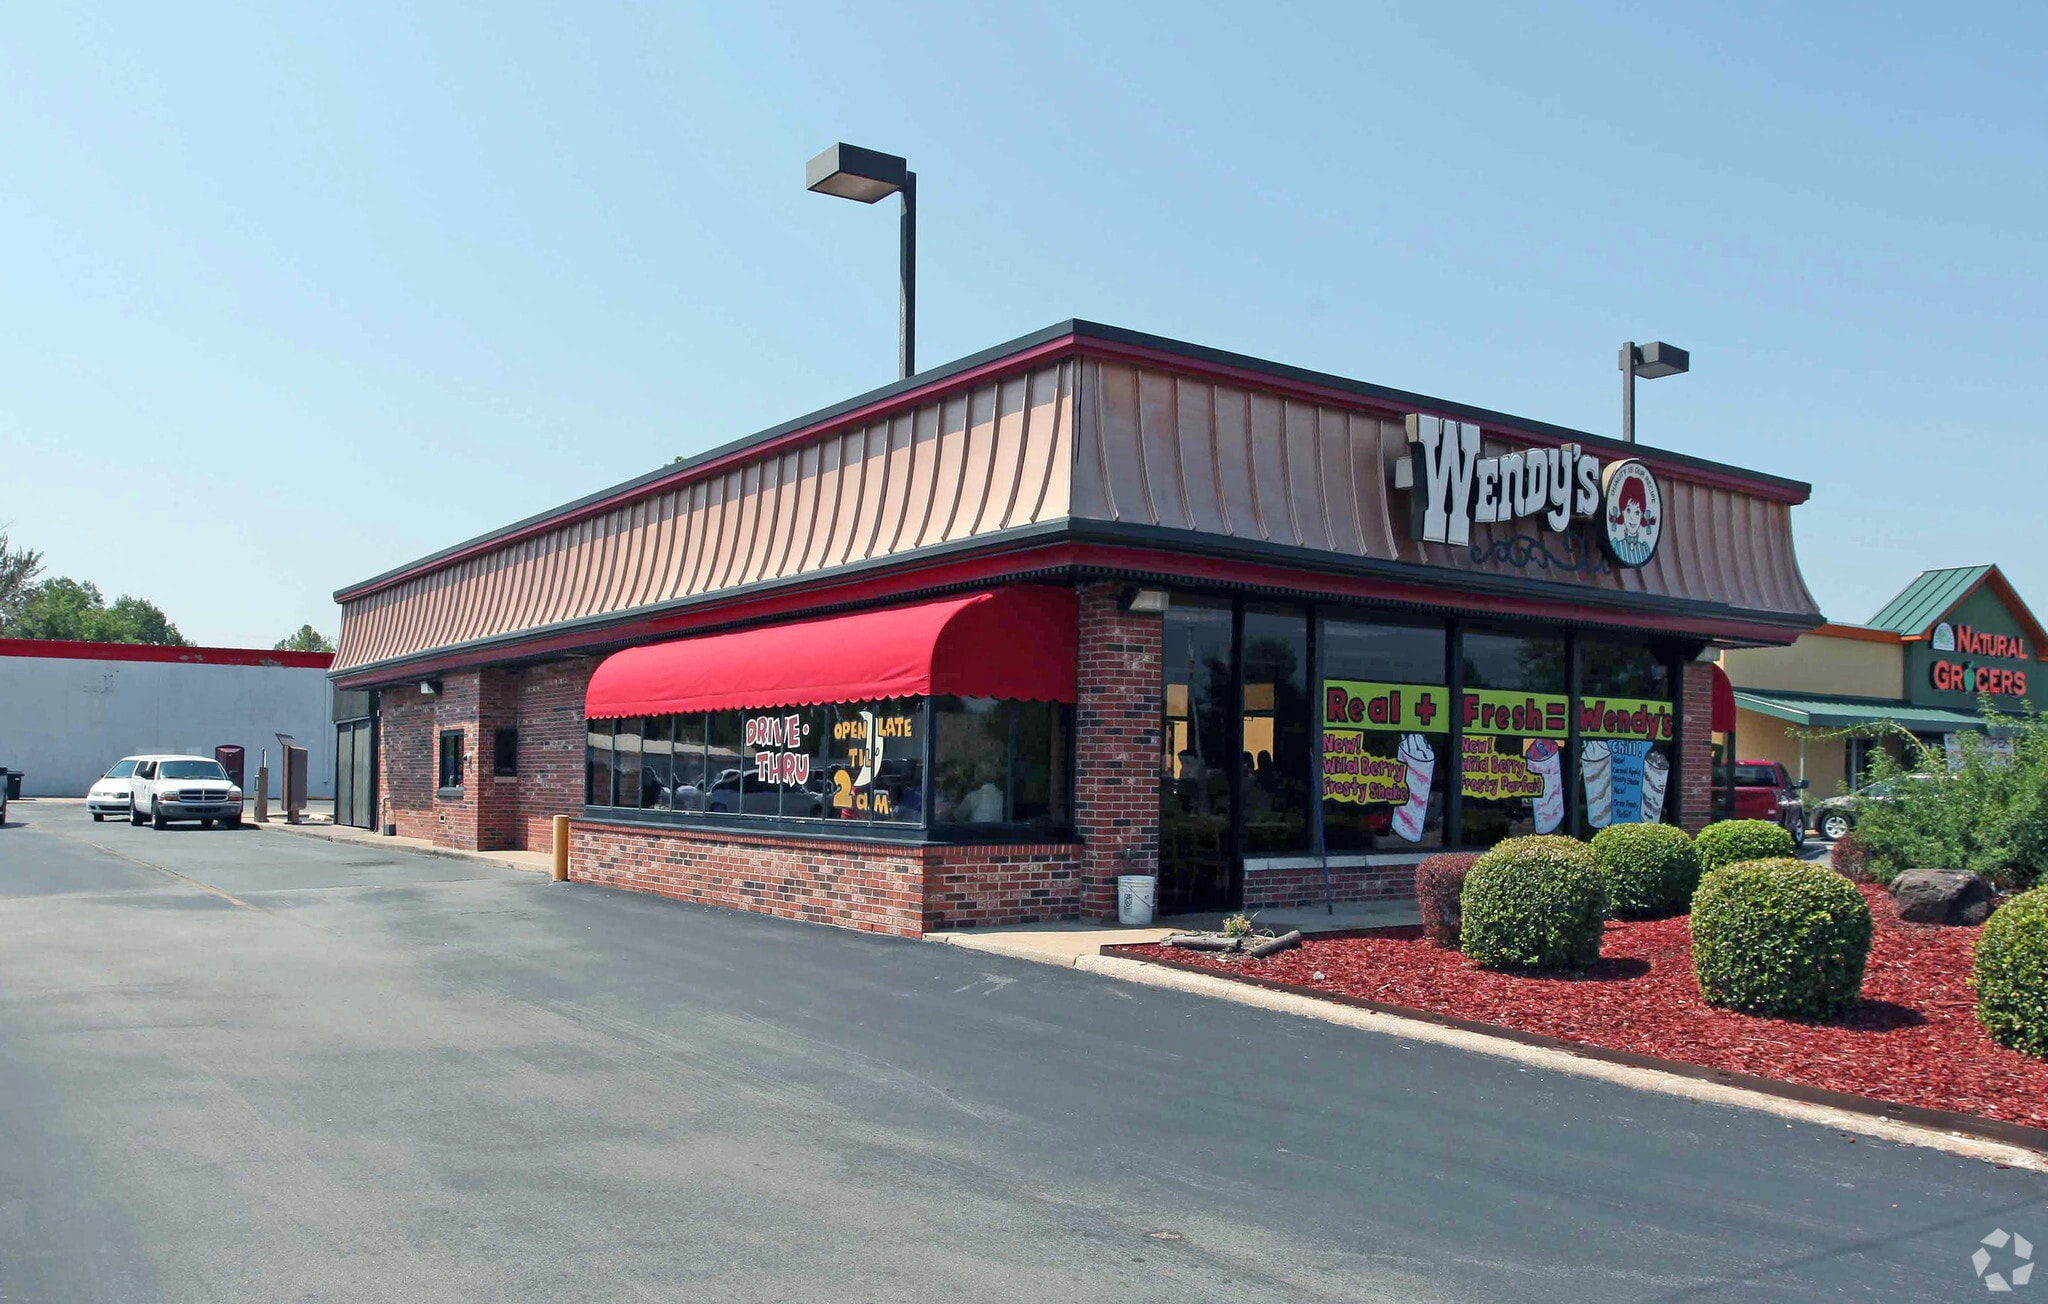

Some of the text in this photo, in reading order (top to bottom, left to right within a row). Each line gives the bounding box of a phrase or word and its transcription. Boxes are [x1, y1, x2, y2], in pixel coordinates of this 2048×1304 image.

[1957, 624, 2028, 659] NATURAL
[1326, 686, 1401, 725] Real
[1580, 701, 1674, 740] Wendy's
[834, 716, 912, 739] OPEN LATE
[1322, 733, 1362, 755] New!
[1461, 736, 1493, 755] New!
[755, 750, 810, 788] THRU
[1322, 756, 1404, 783] Wild Berry
[1461, 755, 1526, 779] Wild Berry
[833, 769, 853, 808] 2
[1322, 777, 1409, 803] Frosty Shake
[1500, 775, 1542, 793] Parfait
